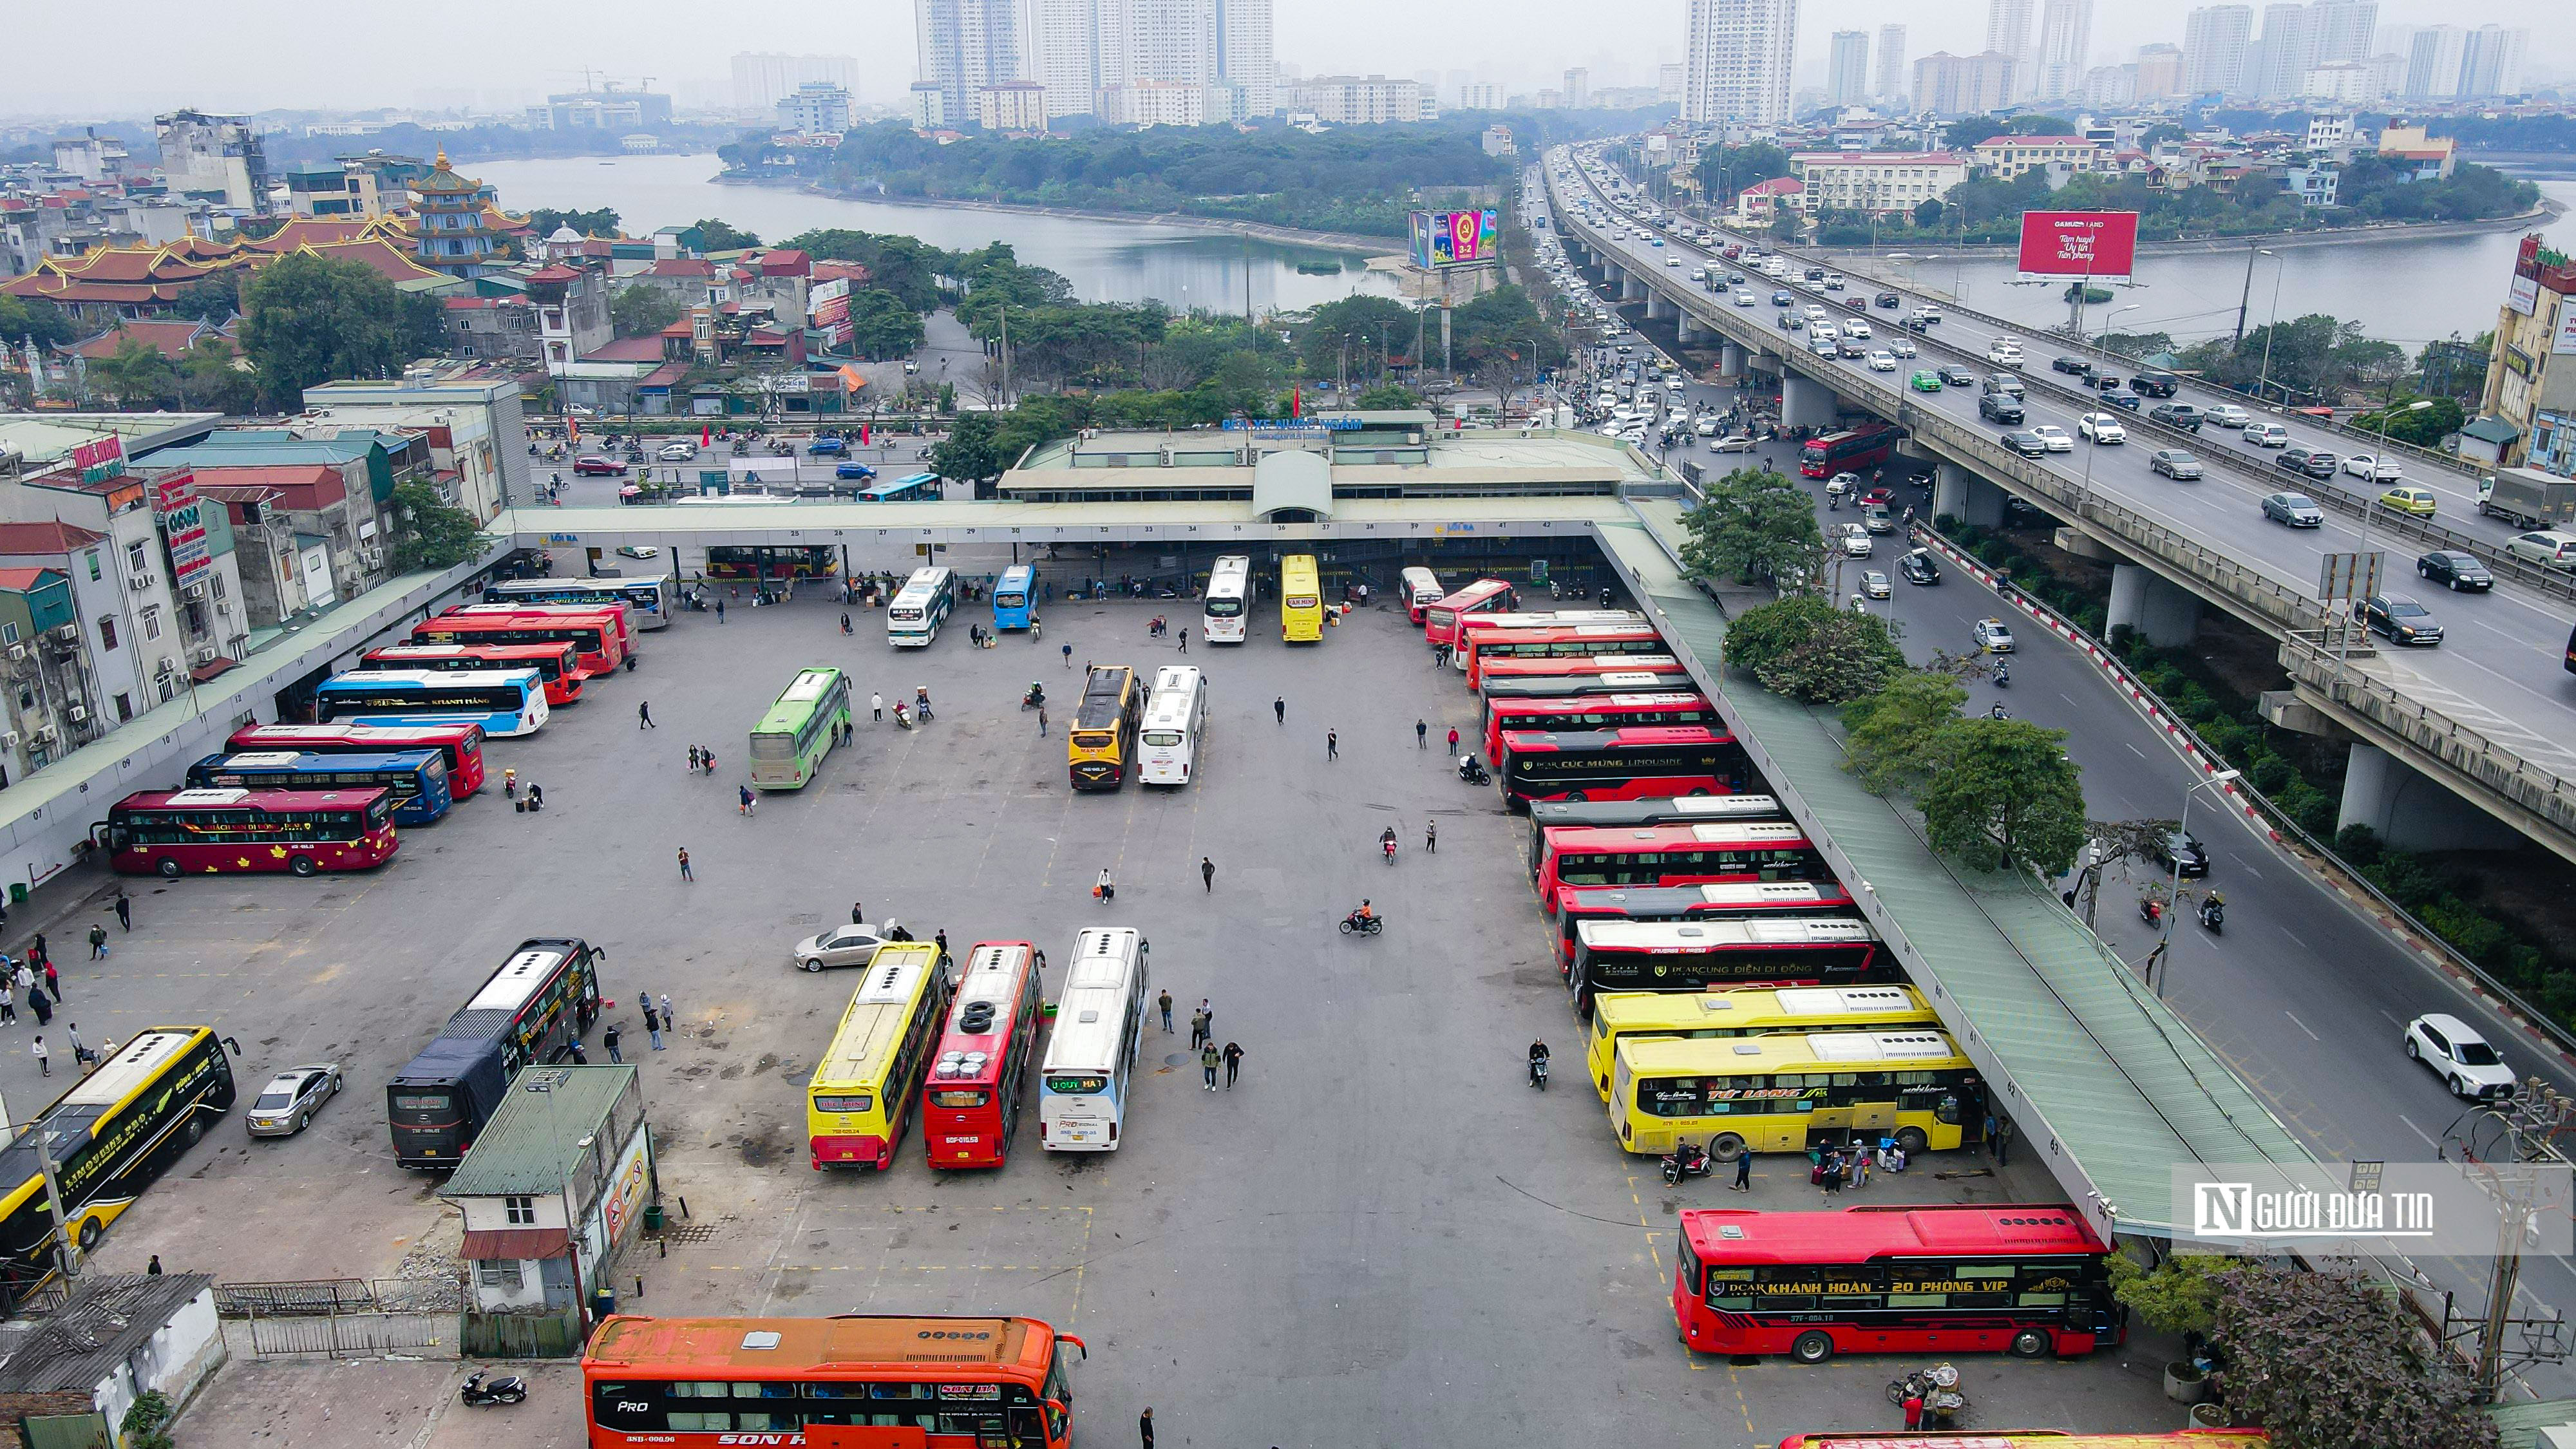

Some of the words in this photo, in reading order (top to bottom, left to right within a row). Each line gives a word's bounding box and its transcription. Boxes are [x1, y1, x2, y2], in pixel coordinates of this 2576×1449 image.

[1459, 245, 1472, 254] 3-2
[352, 625, 358, 634] 17
[234, 694, 243, 703] 12
[200, 714, 207, 724] 11
[162, 736, 170, 745] 10
[122, 758, 131, 769] 09
[1561, 759, 1584, 768] CÚC
[1629, 758, 1683, 766] LIMOUSINE
[79, 782, 89, 794] 08
[33, 808, 43, 820] 07
[1850, 869, 1855, 882] 57
[1904, 942, 1911, 955] 59
[1765, 965, 1777, 974] DI
[1935, 985, 1942, 999] 60
[1969, 1031, 1976, 1045] 61
[1741, 1088, 1804, 1099] LONG
[2007, 1081, 2016, 1097] 62
[65, 1133, 123, 1189] LIMOUSINE
[124, 1113, 146, 1137] PRO
[2050, 1138, 2059, 1156] 63
[1730, 1283, 1765, 1293] DCAR
[1768, 1282, 1822, 1294] KHÁNH
[1828, 1280, 1871, 1293] HOÀN
[1892, 1282, 1914, 1293] 20
[1921, 1279, 1975, 1292] PHÒNG
[1982, 1281, 2009, 1291] VIP
[788, 1435, 807, 1445] H
